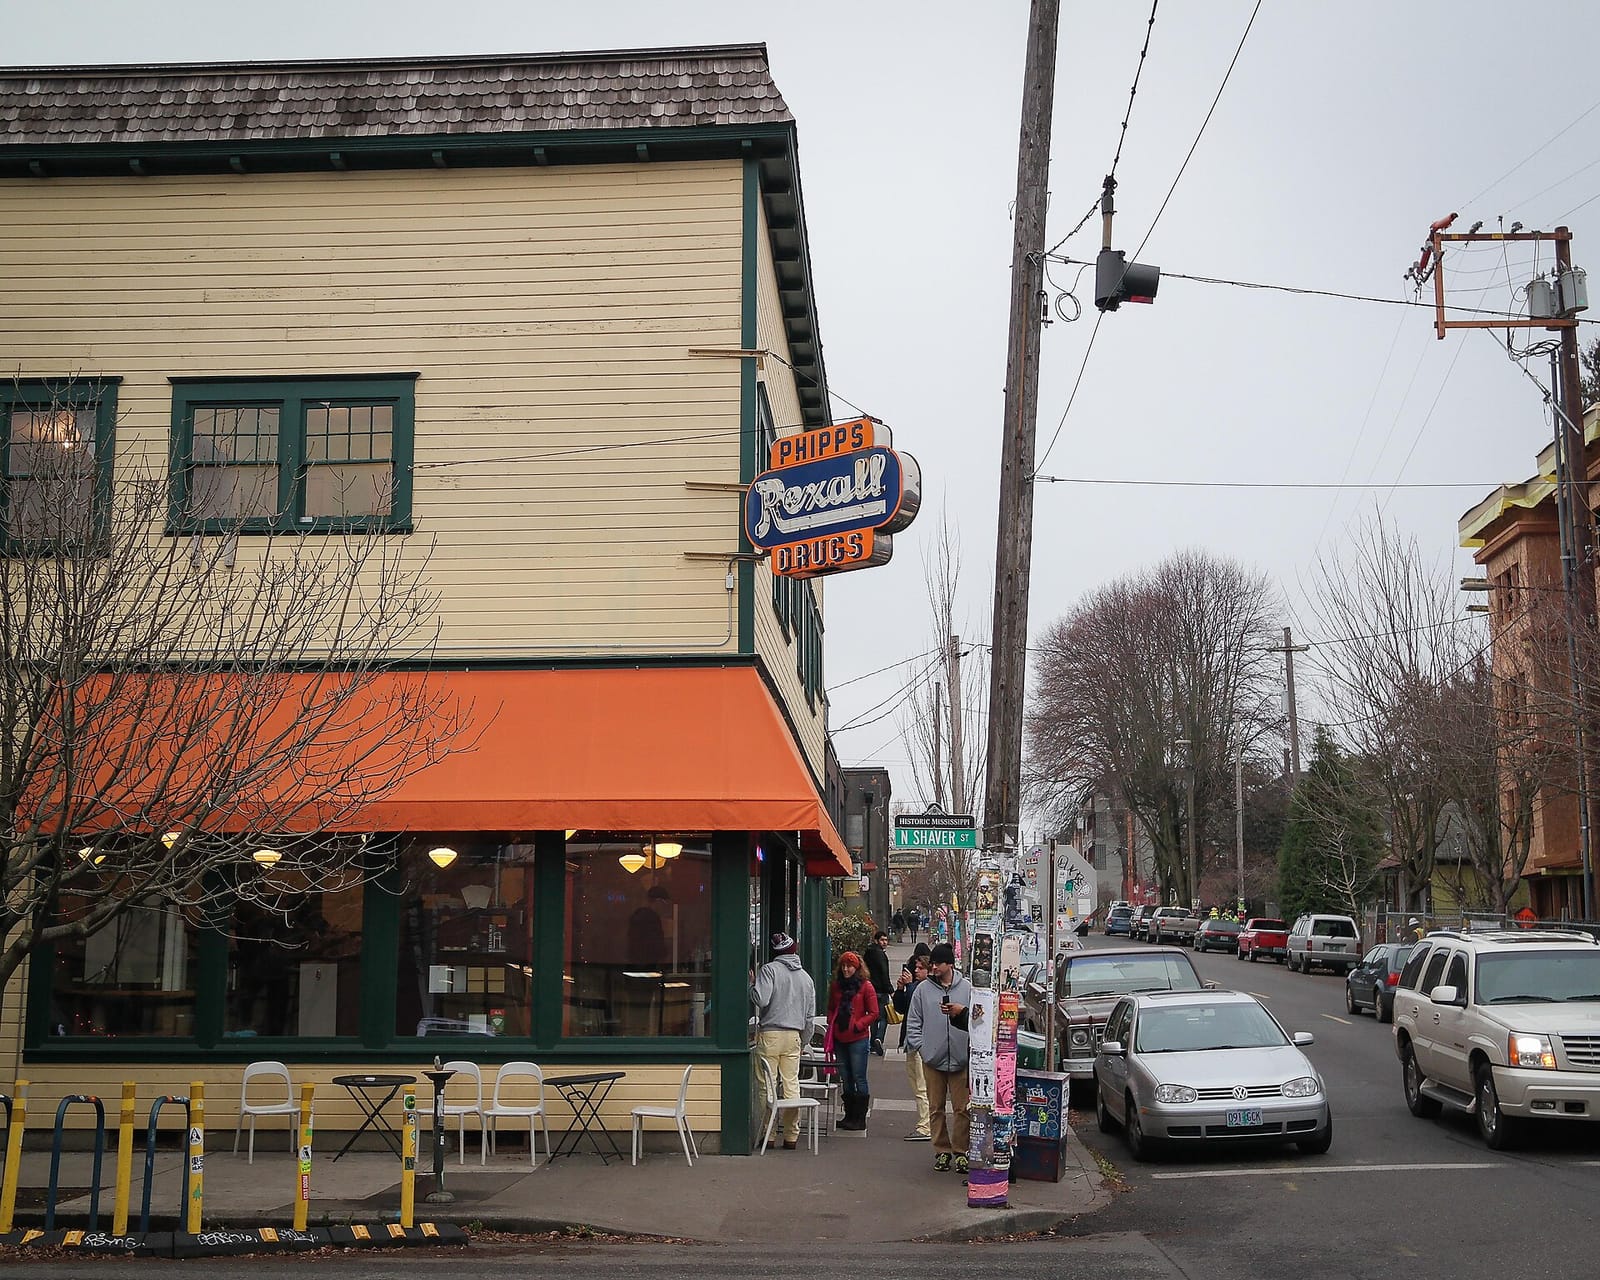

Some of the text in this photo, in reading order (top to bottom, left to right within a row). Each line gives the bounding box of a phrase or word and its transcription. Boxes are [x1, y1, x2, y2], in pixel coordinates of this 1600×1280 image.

[780, 423, 863, 465] PHIPPS
[755, 454, 886, 539] Rexall
[778, 533, 863, 572] DRUGS
[901, 829, 969, 845] N SHAVER ST
[931, 818, 970, 826] MISSISSIPPI
